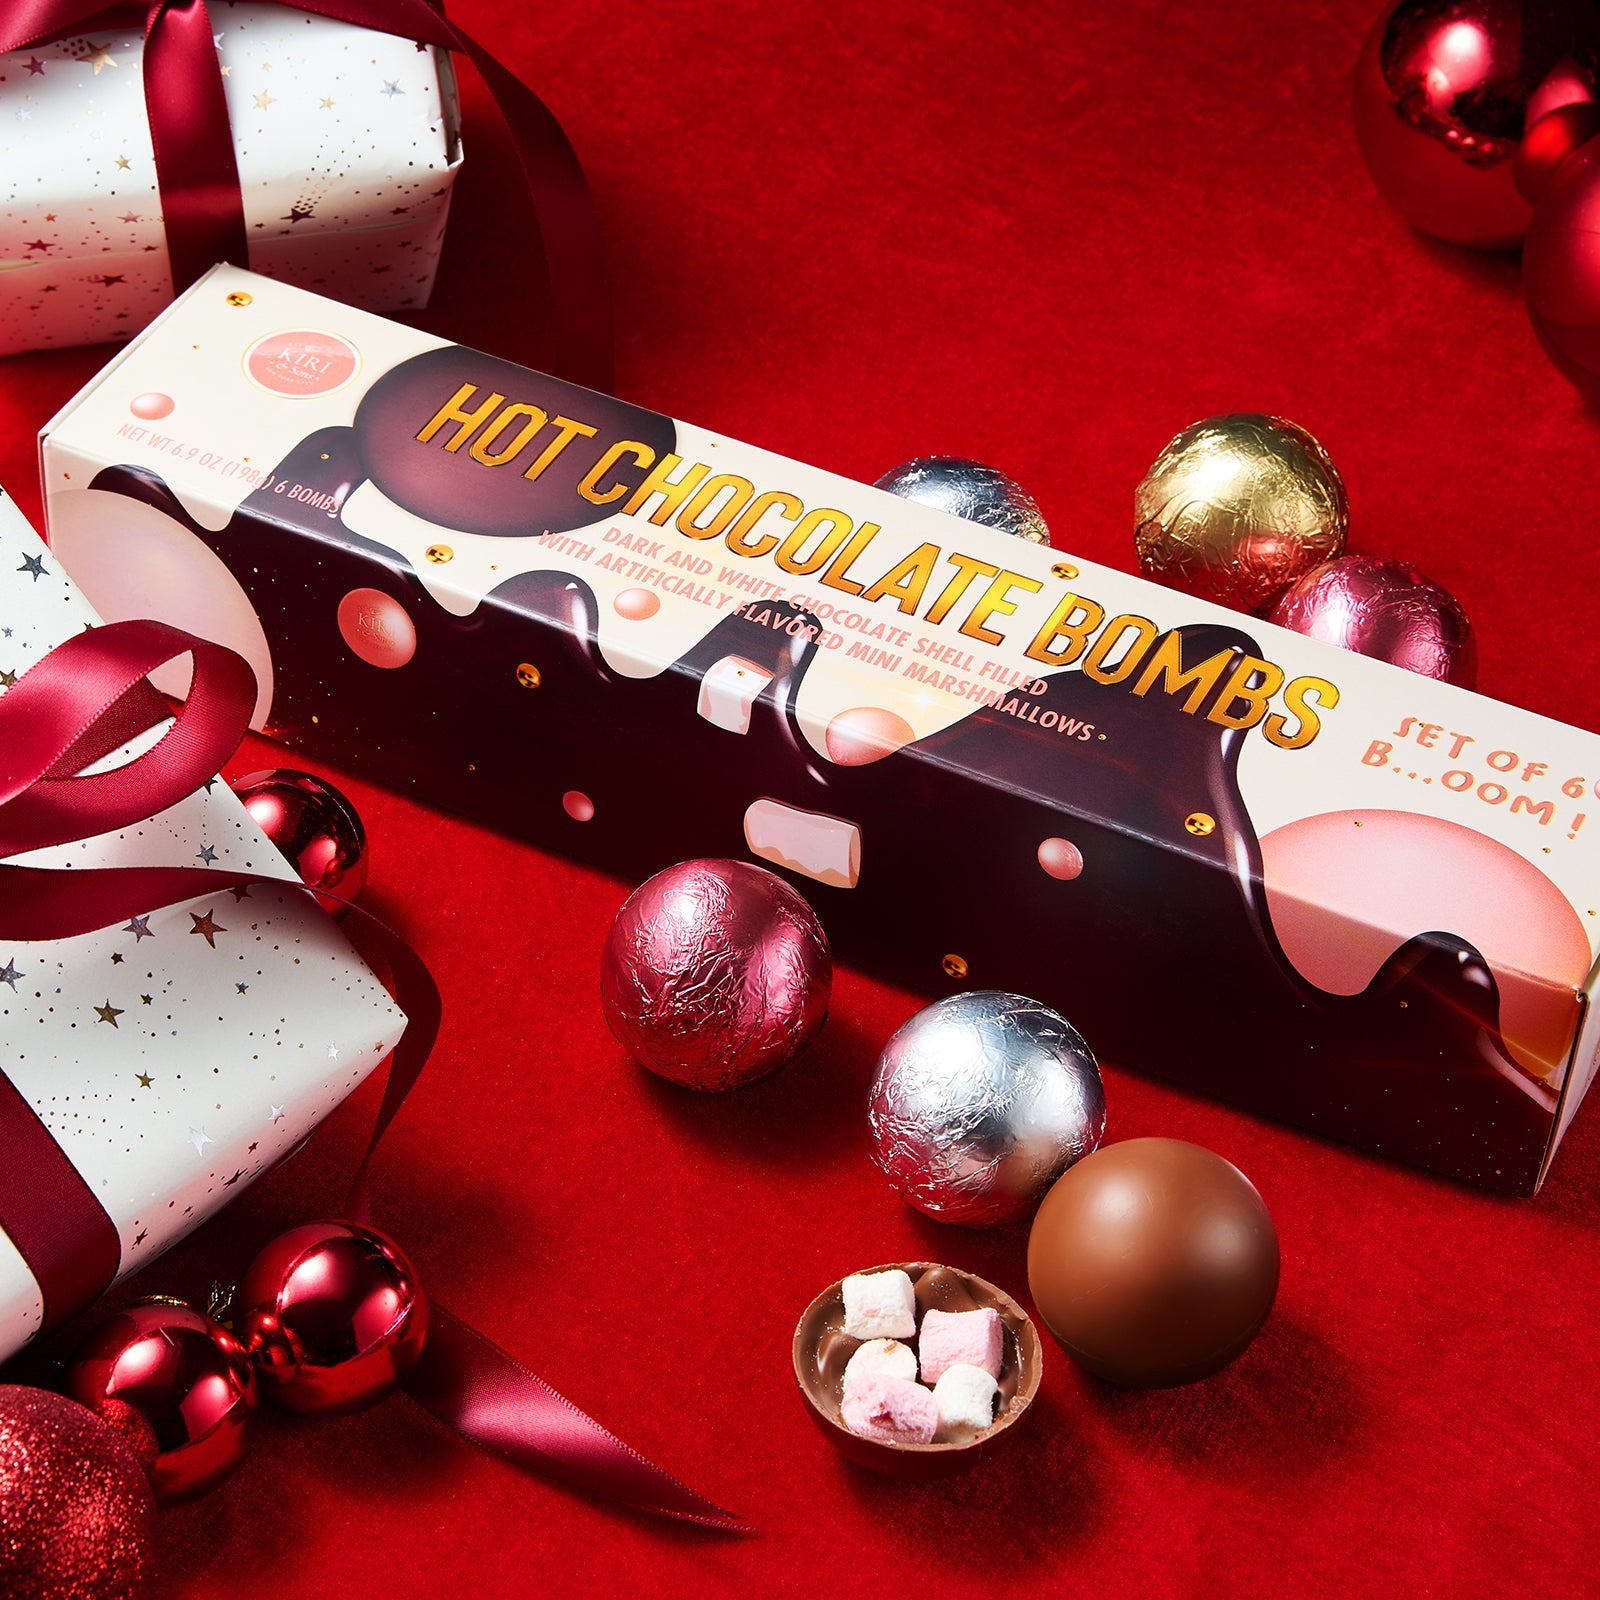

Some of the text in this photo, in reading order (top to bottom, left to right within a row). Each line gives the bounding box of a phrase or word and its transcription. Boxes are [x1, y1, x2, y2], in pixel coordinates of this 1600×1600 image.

[278, 347, 333, 374] KIRI
[116, 423, 344, 514] NET WT 6.9 OZ (198g) 6 BOMBS
[414, 382, 1342, 750] HOT CHOCOLATE BOMBS
[602, 527, 1049, 697] DARK AND WHITE CHOCOLATE SHELL FILLED
[537, 529, 1096, 742] WITH ARTIFICIALLY FLAVORED MINI MARSHMALLOWS
[1392, 716, 1587, 799] SET OF 6
